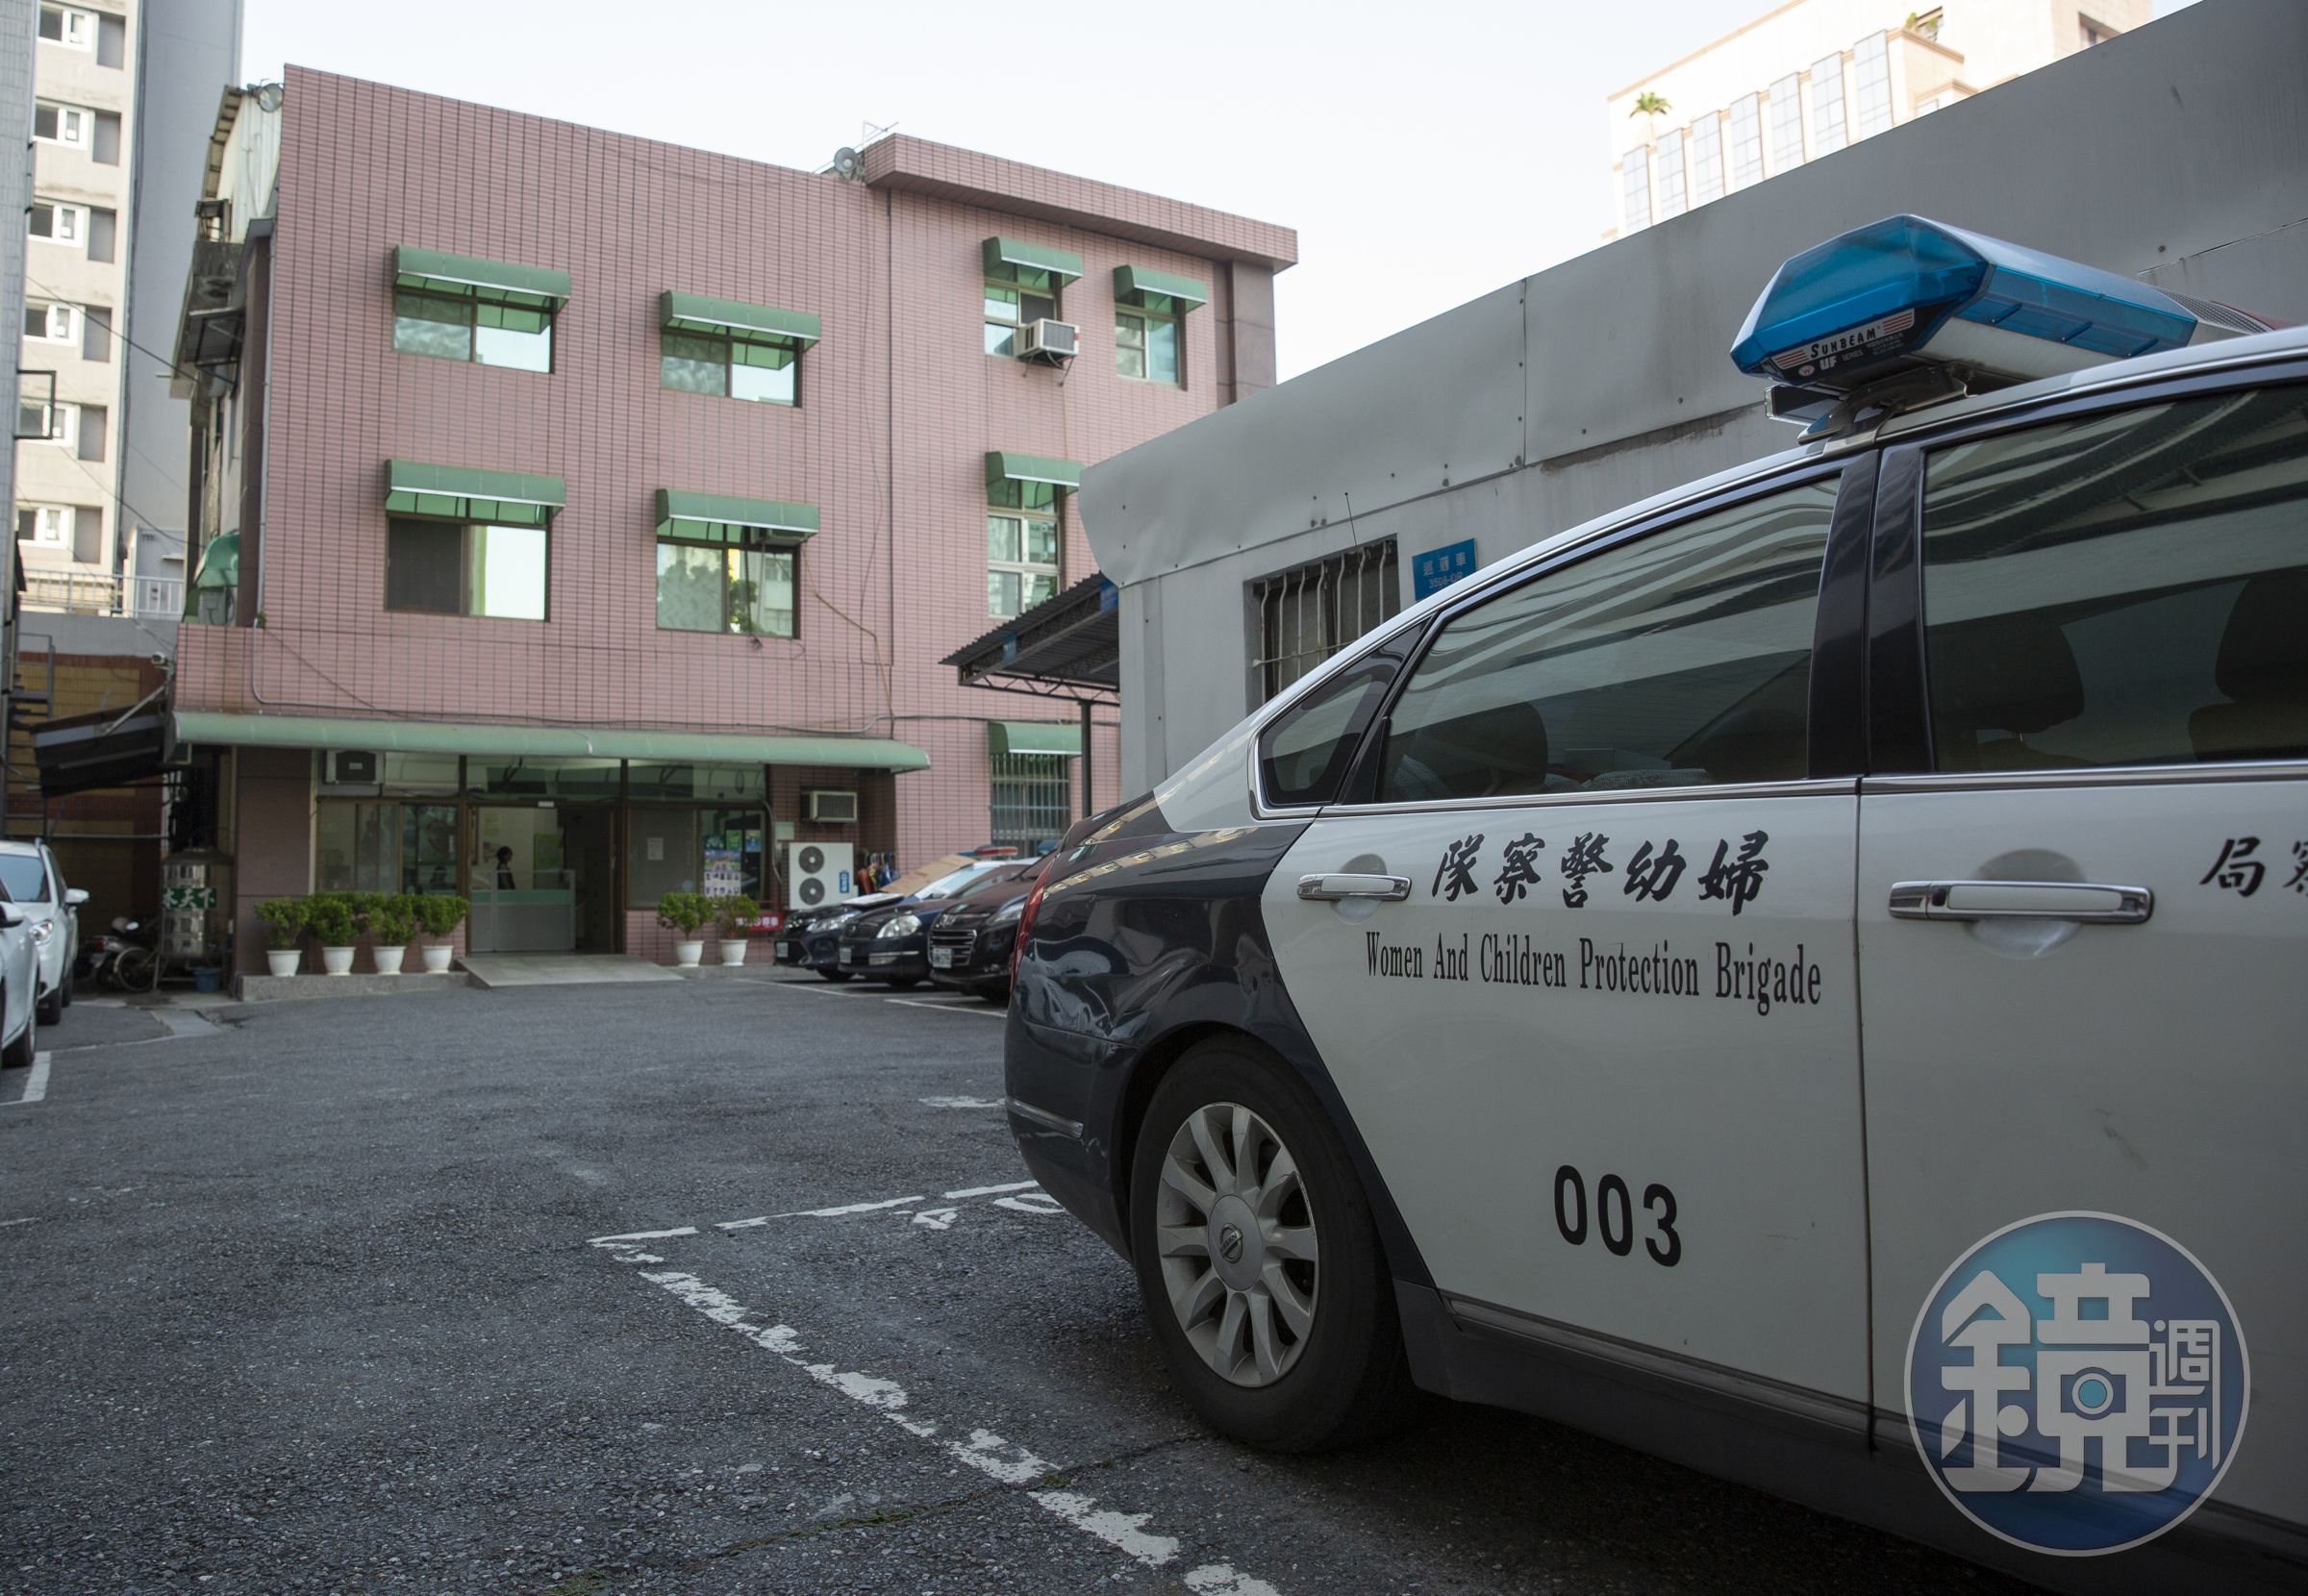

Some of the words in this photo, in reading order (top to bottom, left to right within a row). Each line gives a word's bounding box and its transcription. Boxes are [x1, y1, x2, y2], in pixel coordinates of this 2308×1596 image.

[1811, 328, 1876, 359] SUNBEAM
[1819, 356, 1837, 371] UF
[1366, 931, 1424, 979] Women
[1433, 933, 1469, 982] And
[1480, 933, 1568, 988] Children
[1579, 937, 1700, 997] Protection
[1715, 941, 1822, 1016] Brigade
[1554, 1164, 1682, 1268] 003
